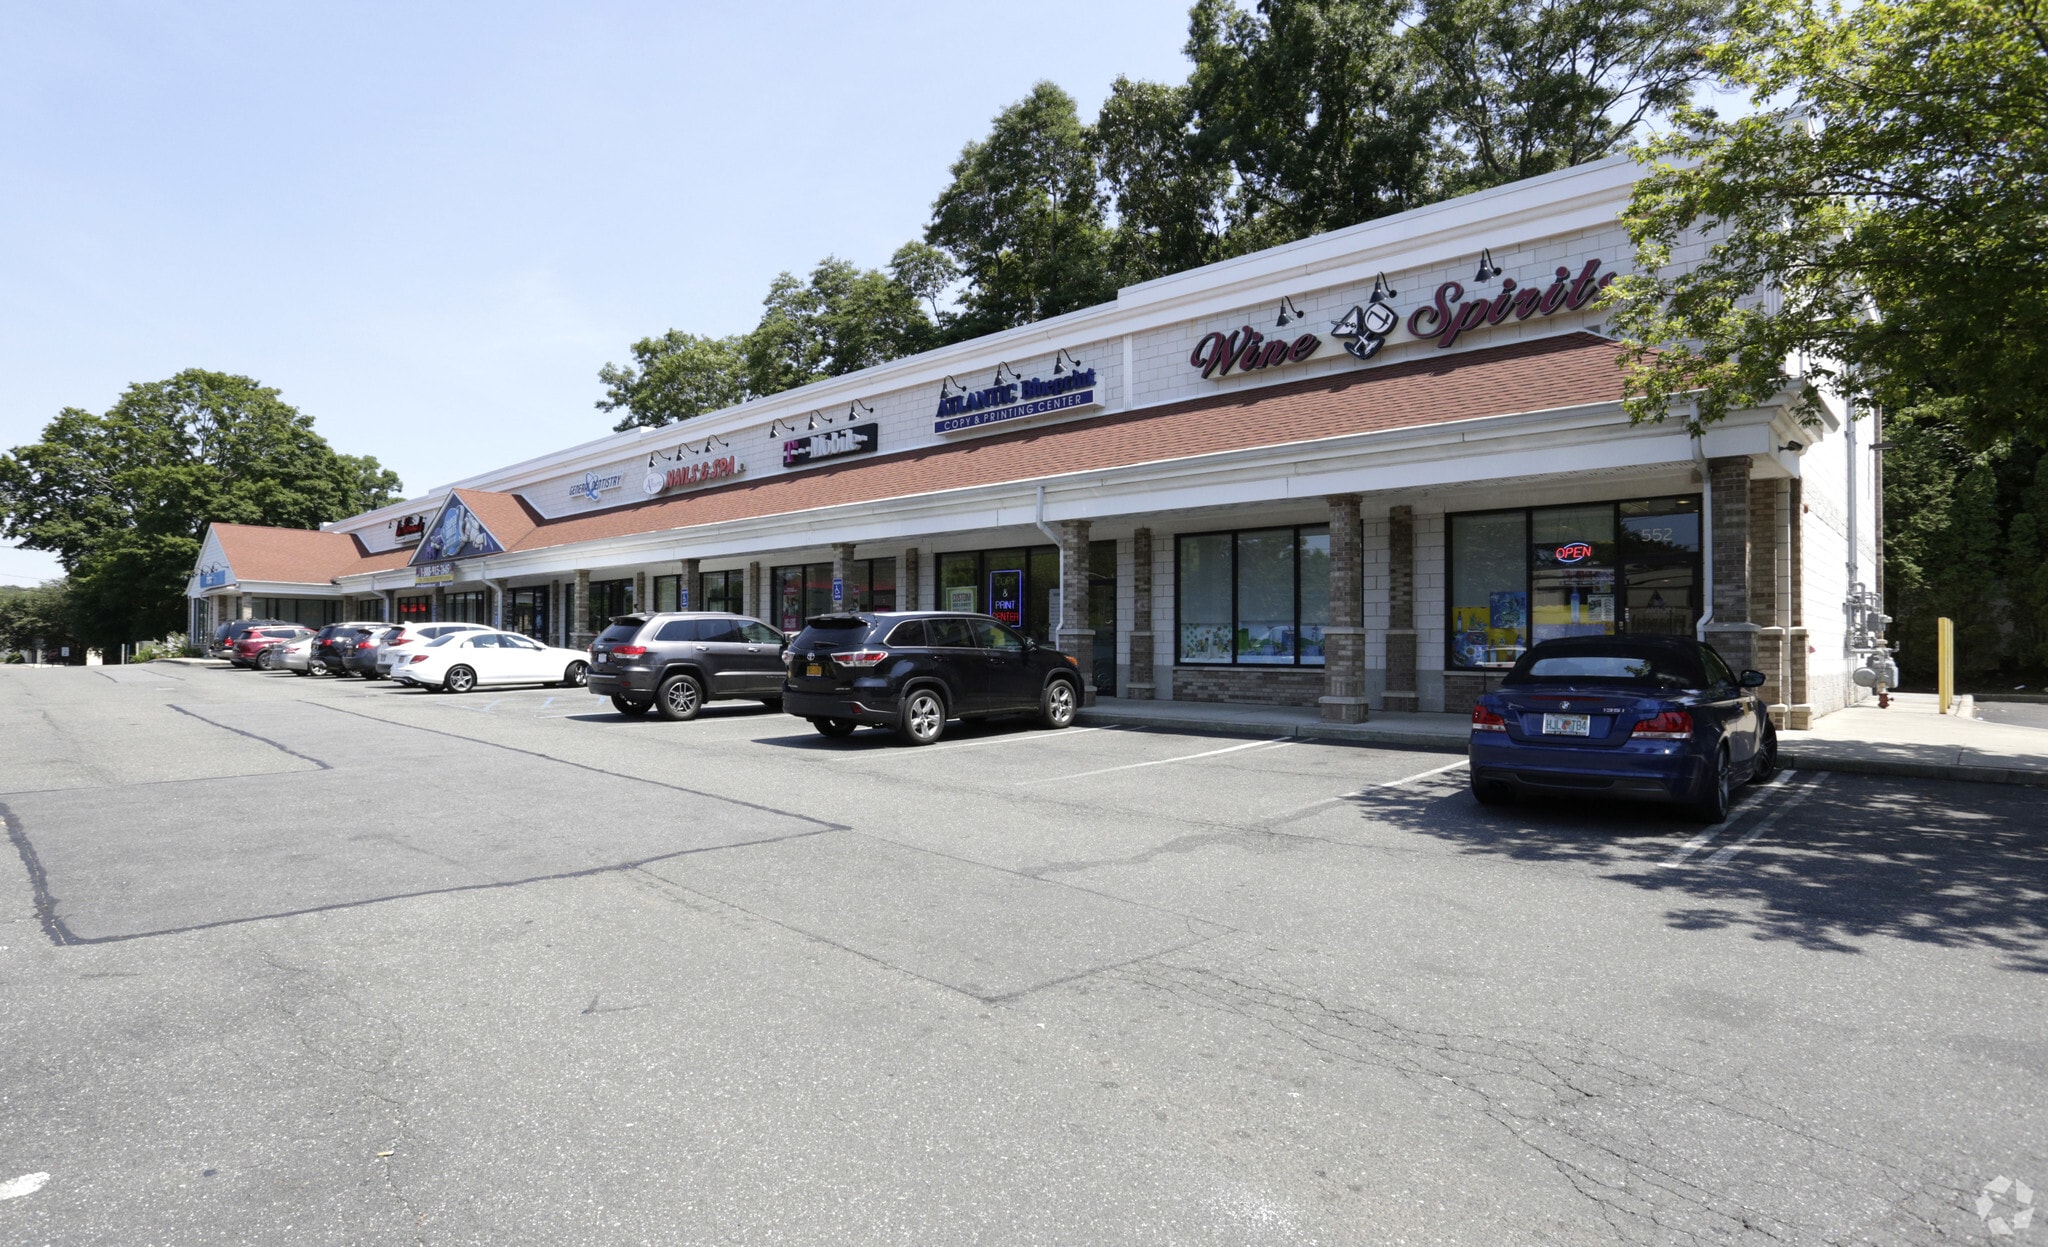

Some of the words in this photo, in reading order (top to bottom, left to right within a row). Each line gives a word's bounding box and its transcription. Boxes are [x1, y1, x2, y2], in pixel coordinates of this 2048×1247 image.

[1190, 325, 1322, 379] Wine
[935, 382, 1018, 418] ATLANTIC
[1020, 368, 1097, 401] Blueprint
[944, 416, 971, 430] COPY
[974, 416, 980, 425] &
[983, 404, 1034, 423] PRINTING
[1037, 394, 1082, 412] CENTER
[666, 464, 698, 488] NAILS
[700, 461, 709, 481] &
[711, 455, 735, 478] SPA
[1641, 527, 1673, 542] 552
[1555, 545, 1592, 560] OPEN
[995, 576, 1016, 587] COPY
[995, 600, 1016, 610] PRINT
